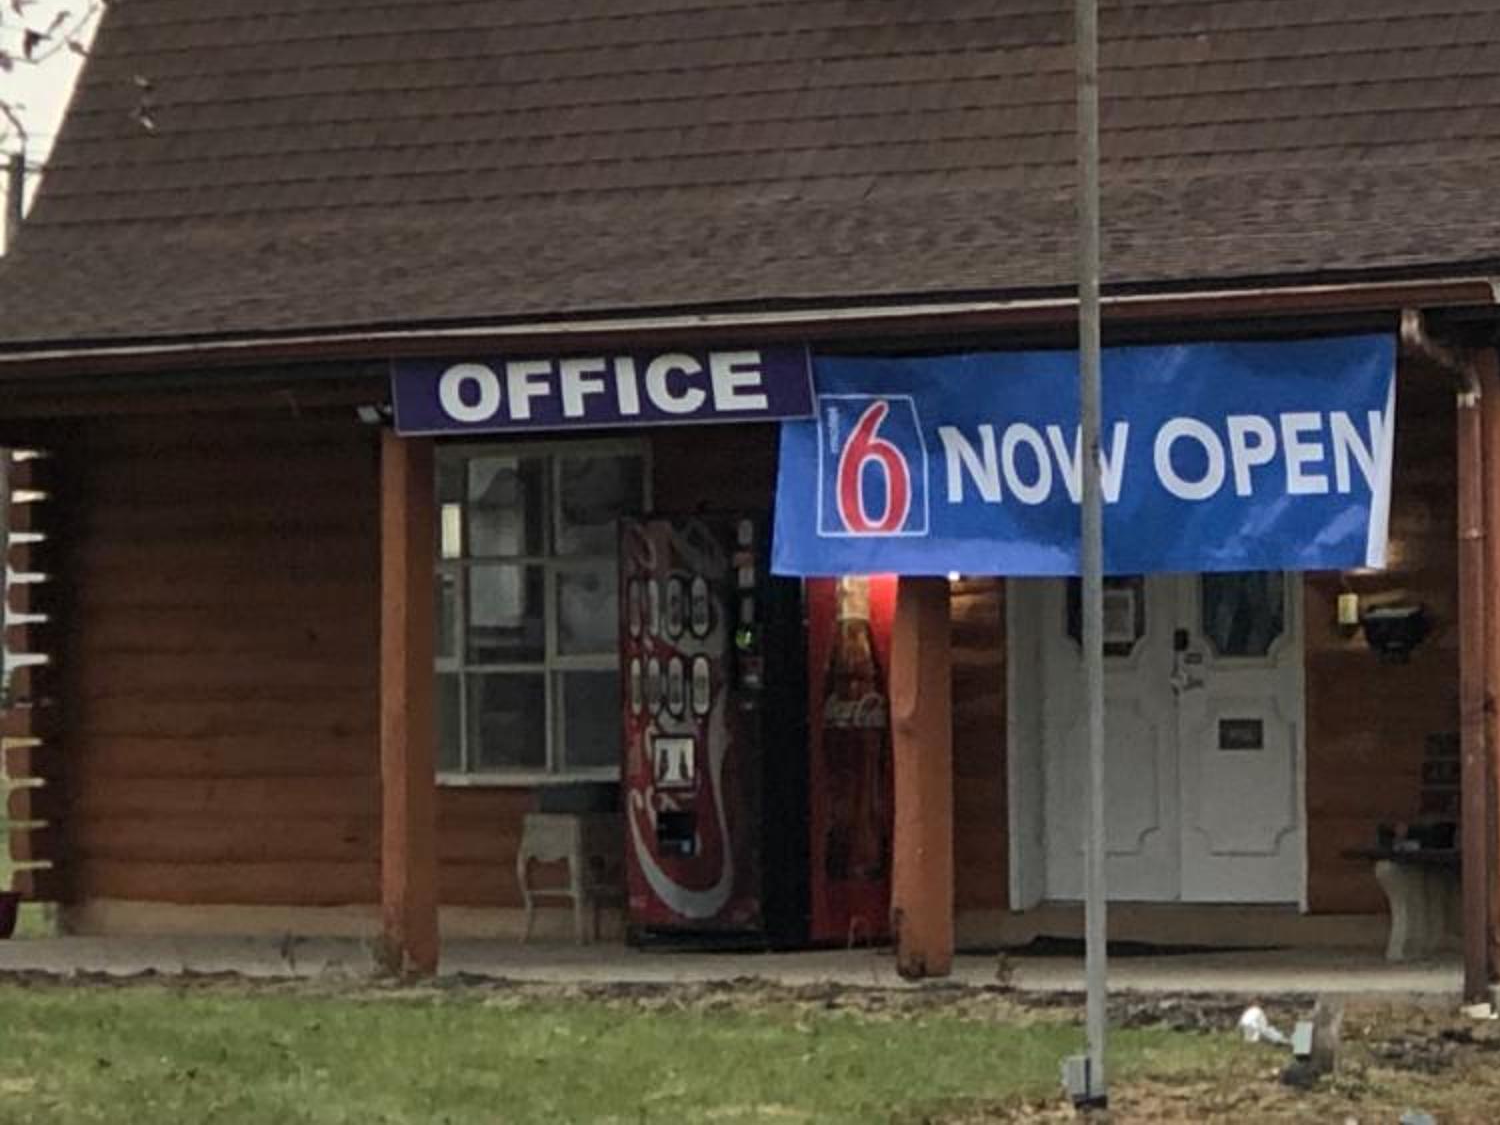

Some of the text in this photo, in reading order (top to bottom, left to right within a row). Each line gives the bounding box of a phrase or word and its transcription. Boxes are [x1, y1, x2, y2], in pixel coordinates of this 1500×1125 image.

[439, 350, 769, 423] OFFICE
[837, 400, 912, 537] 6
[938, 421, 1129, 506] NOW
[1154, 410, 1388, 500] OPEN
